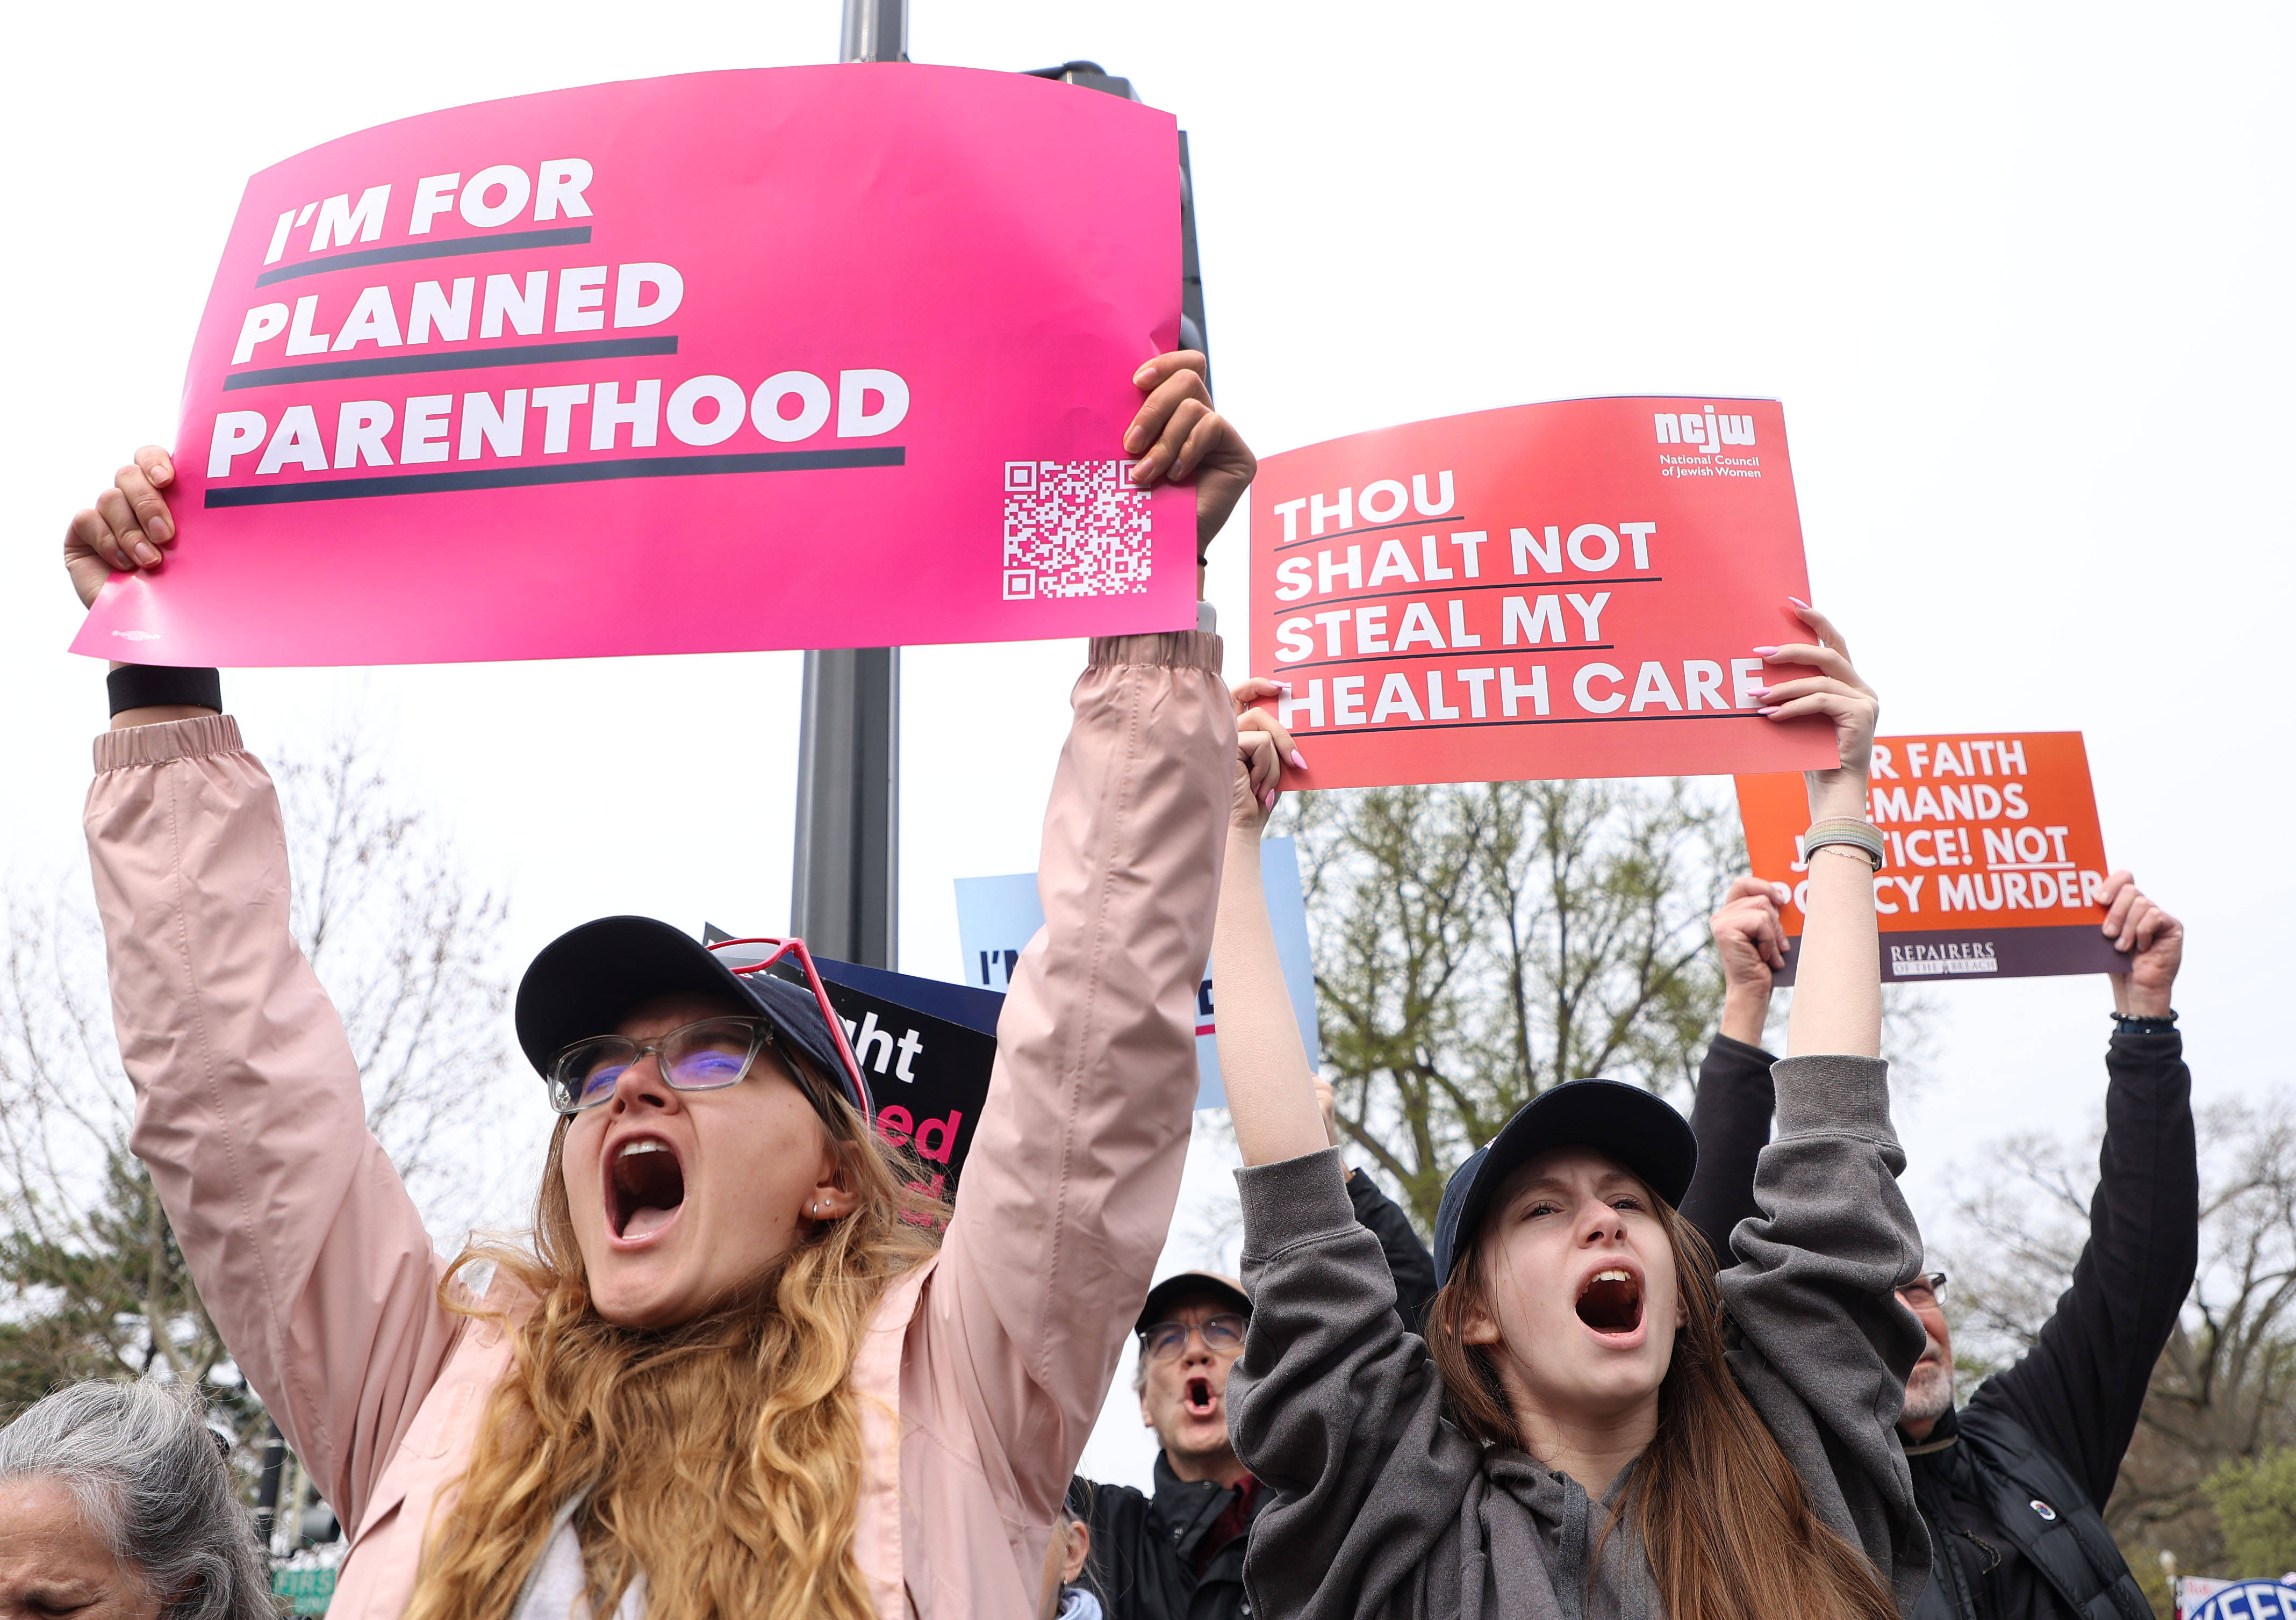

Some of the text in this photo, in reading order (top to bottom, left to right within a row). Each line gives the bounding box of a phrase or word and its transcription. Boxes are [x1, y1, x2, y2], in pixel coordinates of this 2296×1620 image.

[263, 159, 593, 265] I'M FOR
[231, 263, 683, 365] PLANNED
[207, 369, 909, 478] PARENTHOOD
[1654, 405, 1755, 453] ncjw
[1660, 455, 1760, 466] National Council
[1662, 466, 1762, 479] of Jewish Women
[1274, 470, 1454, 542] THOU
[1275, 522, 1656, 601] SHALT NOT
[1275, 593, 1611, 662] STEAL MY
[1278, 658, 1767, 730] HEALTH CARE
[1906, 740, 2028, 779] FAITH
[1866, 783, 2029, 823] MANDS
[1790, 825, 2069, 872] JICE! NOT
[1938, 869, 2104, 912] MURDER
[1891, 942, 1996, 961] REPAIRERS
